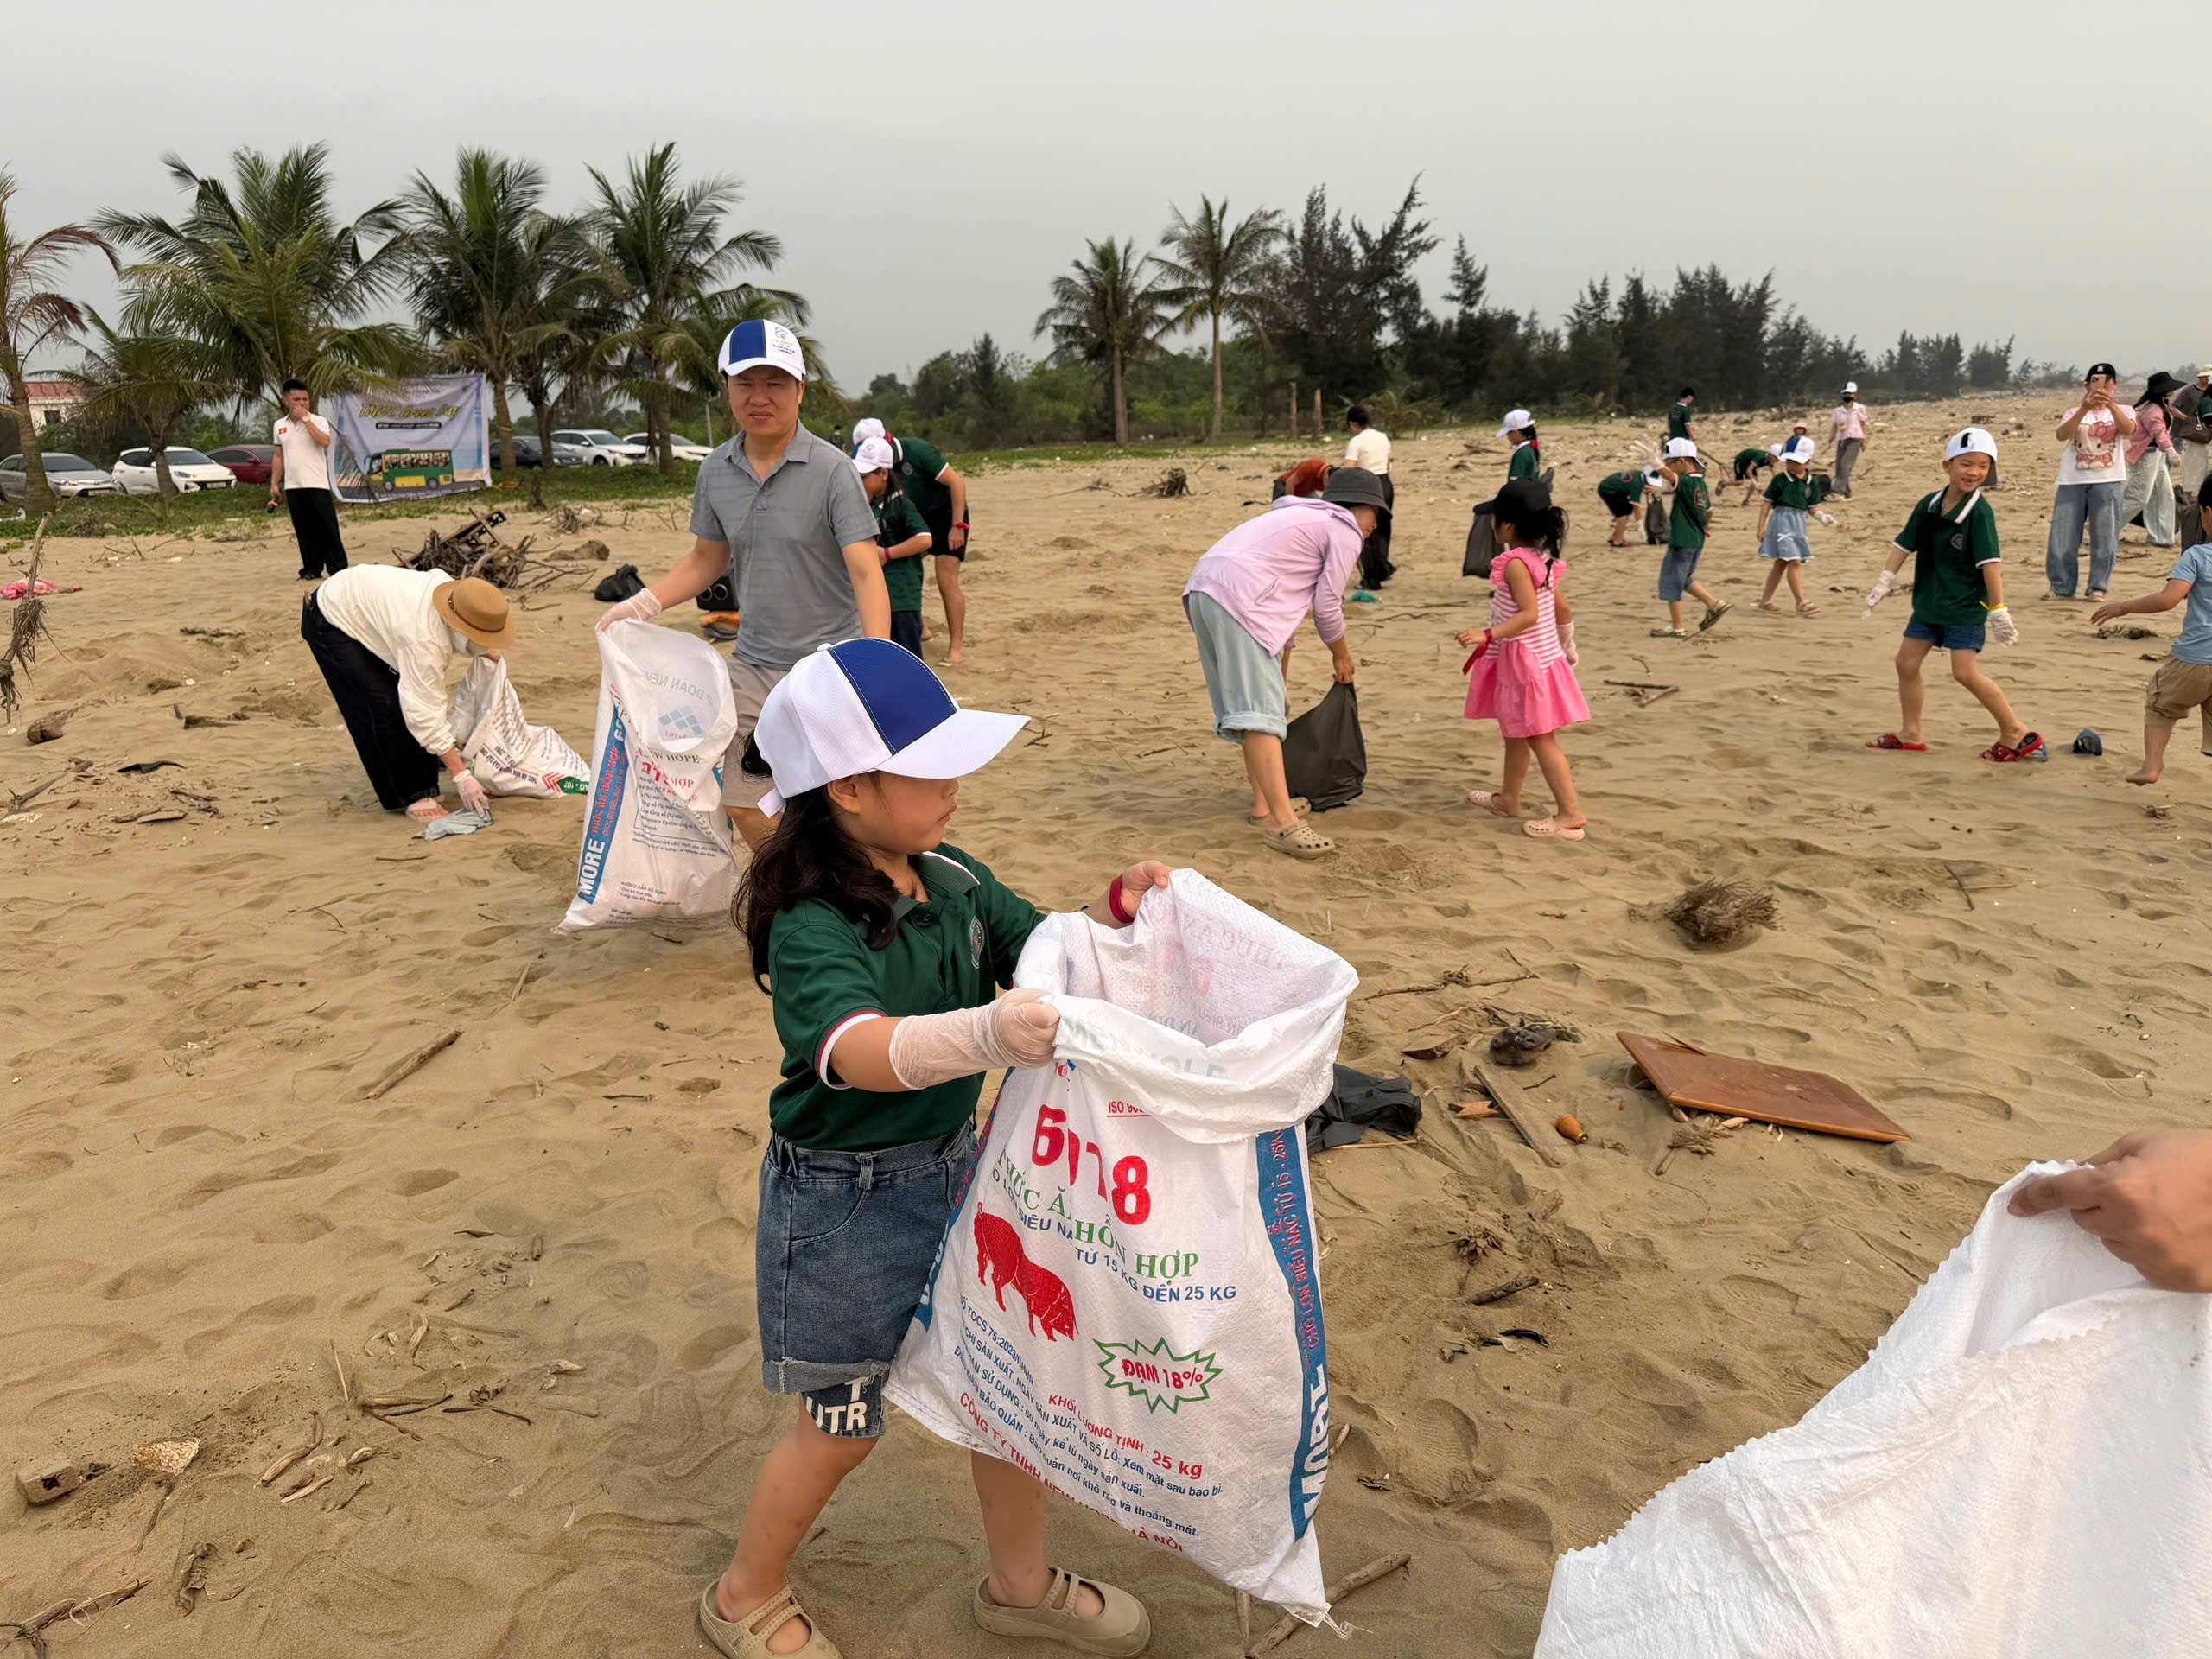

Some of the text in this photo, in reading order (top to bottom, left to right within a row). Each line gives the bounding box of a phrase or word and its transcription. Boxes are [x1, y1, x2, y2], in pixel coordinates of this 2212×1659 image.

[578, 837, 606, 895] MORE
[1109, 1101, 1124, 1113] ISO
[1277, 1172, 1293, 1191] 15
[1019, 1207, 1052, 1231] SIÊU
[1103, 1255, 1118, 1273] 15
[1185, 1286, 1205, 1300] 25
[1210, 1286, 1236, 1300] KG
[1075, 1213, 1127, 1265] HỖN
[1135, 1249, 1199, 1286] HỢP
[967, 1305, 988, 1332] TCCS
[1122, 1358, 1204, 1389] ĐẠM 18%
[959, 1392, 989, 1434] CÔNG
[991, 1427, 1007, 1449] TY
[976, 1340, 993, 1360] SẢN
[1016, 1377, 1034, 1403] NGÀY
[1052, 1414, 1077, 1433] XUẤT
[1090, 1441, 1104, 1457] SỐ
[1122, 1457, 1144, 1475] Xem
[1146, 1472, 1165, 1487] mặt
[1166, 1481, 1185, 1495] sau
[1188, 1485, 1210, 1497] bao
[995, 1380, 1020, 1408] DỤNG
[1052, 1436, 1069, 1450] kể
[1077, 1453, 1099, 1476] ngày
[1048, 1394, 1077, 1415] KHỐI
[1152, 1449, 1173, 1470] 25
[1179, 1460, 1203, 1480] kg
[979, 1389, 996, 1411] BẢO
[997, 1408, 1024, 1433] QUẢN
[1082, 1476, 1101, 1494] khô
[1119, 1500, 1132, 1513] và
[1134, 1505, 1173, 1528] thoáng
[1174, 1523, 1200, 1537] mát.
